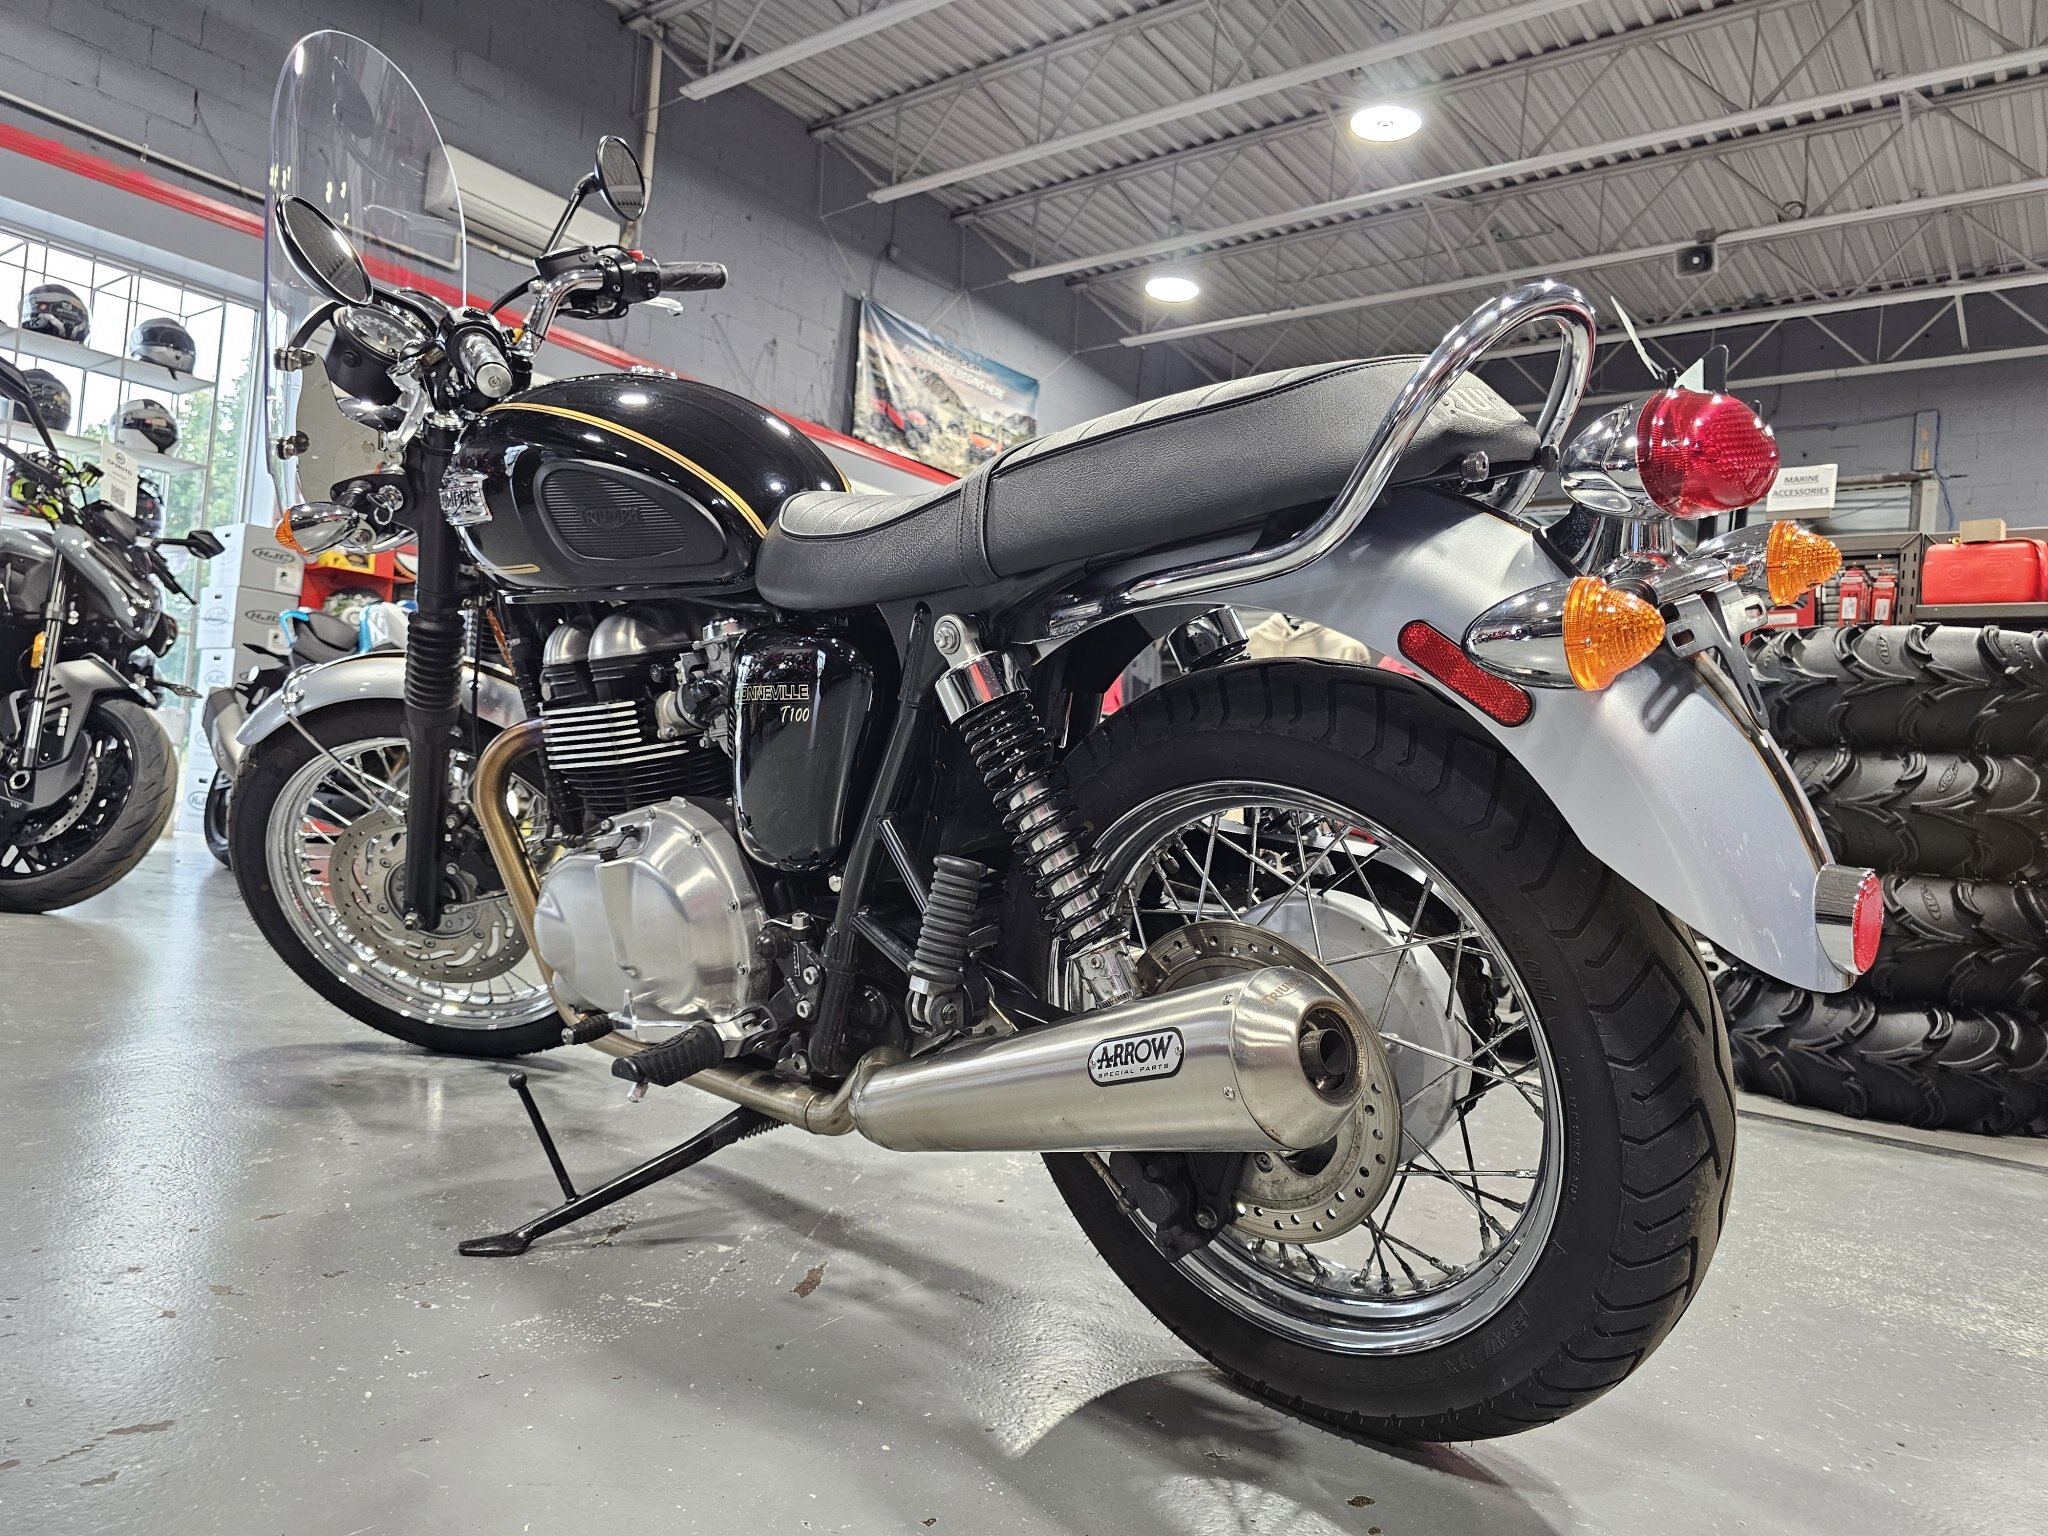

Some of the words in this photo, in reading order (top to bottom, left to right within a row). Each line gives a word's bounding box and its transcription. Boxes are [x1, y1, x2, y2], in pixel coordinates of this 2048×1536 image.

[1784, 475, 1819, 483] MARINE
[1772, 487, 1830, 497] ACCESSORIES
[738, 684, 809, 700] ONNEVILLE
[780, 705, 810, 723] T100
[1097, 1035, 1173, 1069] ARROW
[1098, 1069, 1134, 1079] SPECIAL
[1140, 1063, 1169, 1072] PARTS
